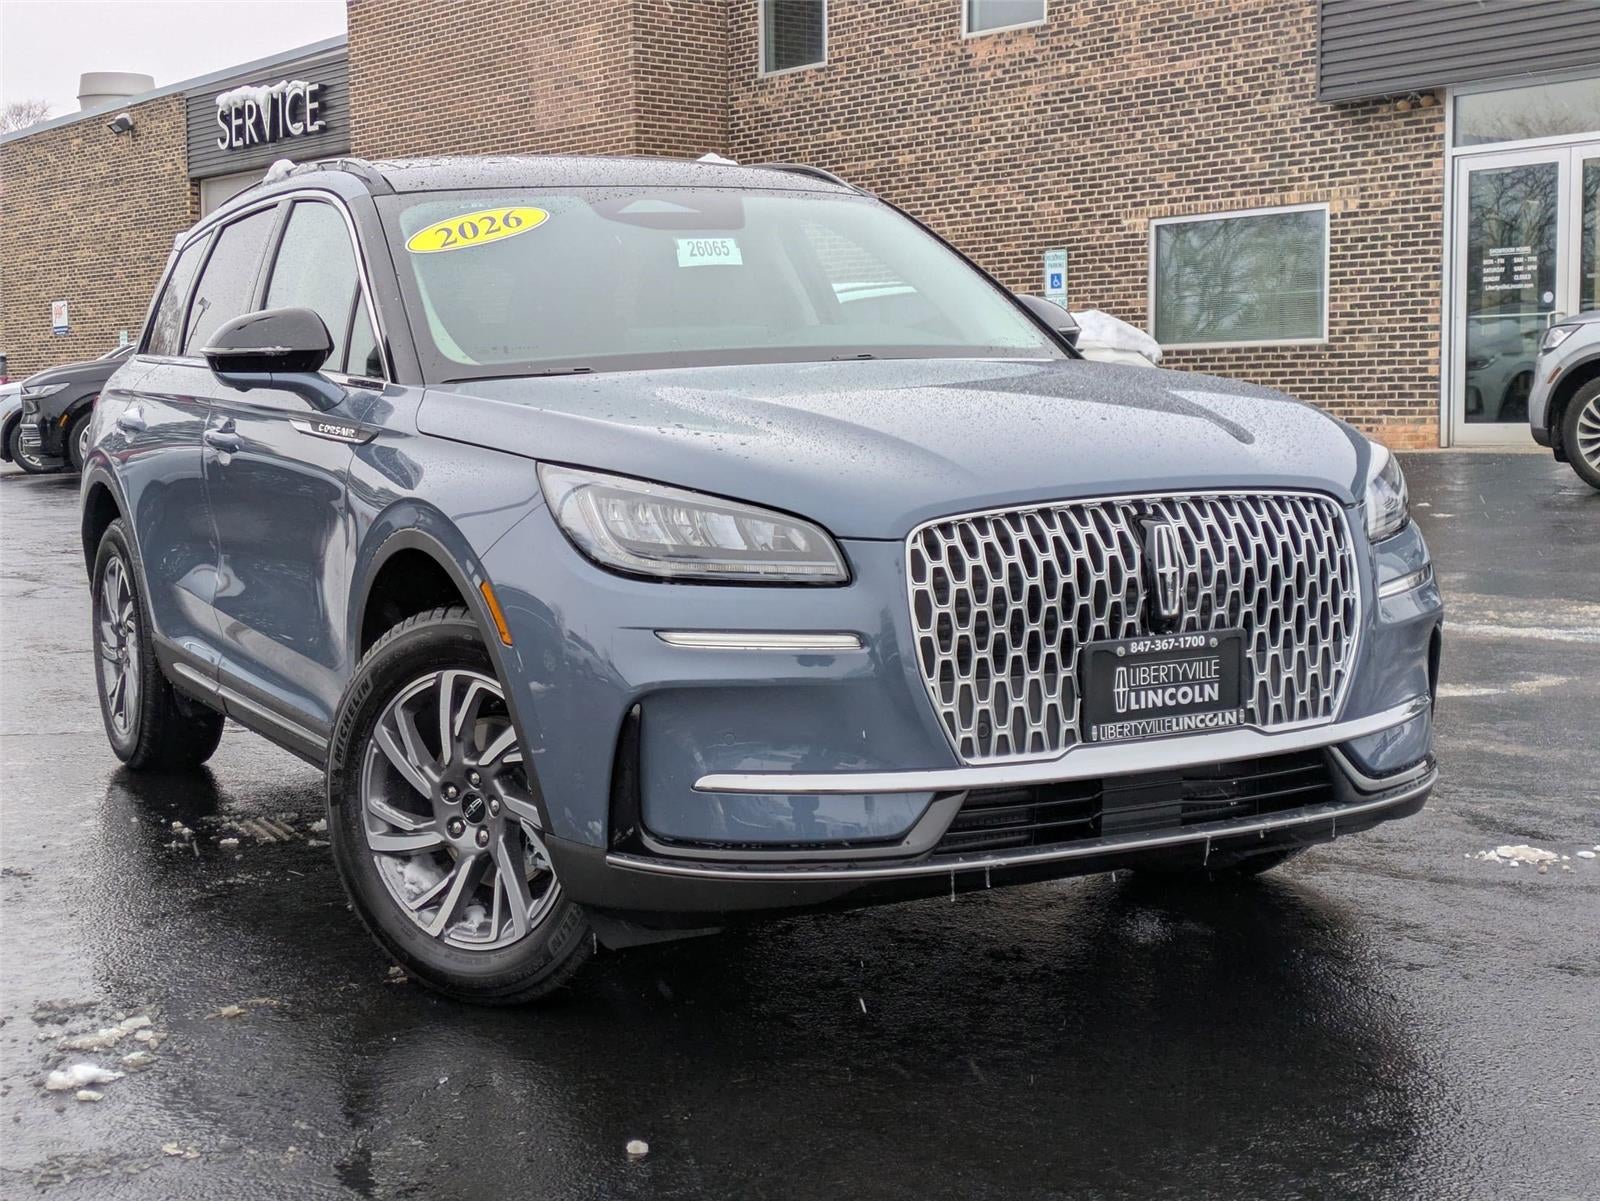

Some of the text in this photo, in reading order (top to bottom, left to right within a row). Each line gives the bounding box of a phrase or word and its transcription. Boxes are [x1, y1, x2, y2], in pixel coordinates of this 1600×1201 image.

[216, 82, 323, 151] SERVICE
[434, 209, 523, 248] 2026
[687, 240, 730, 257] 26065
[318, 423, 356, 438] CORSAIR
[1130, 635, 1206, 654] 847-367-1700
[1130, 659, 1220, 687] LIBERTYVILLE
[1130, 683, 1220, 710] LINCOLN
[334, 677, 372, 765] MICHELIN
